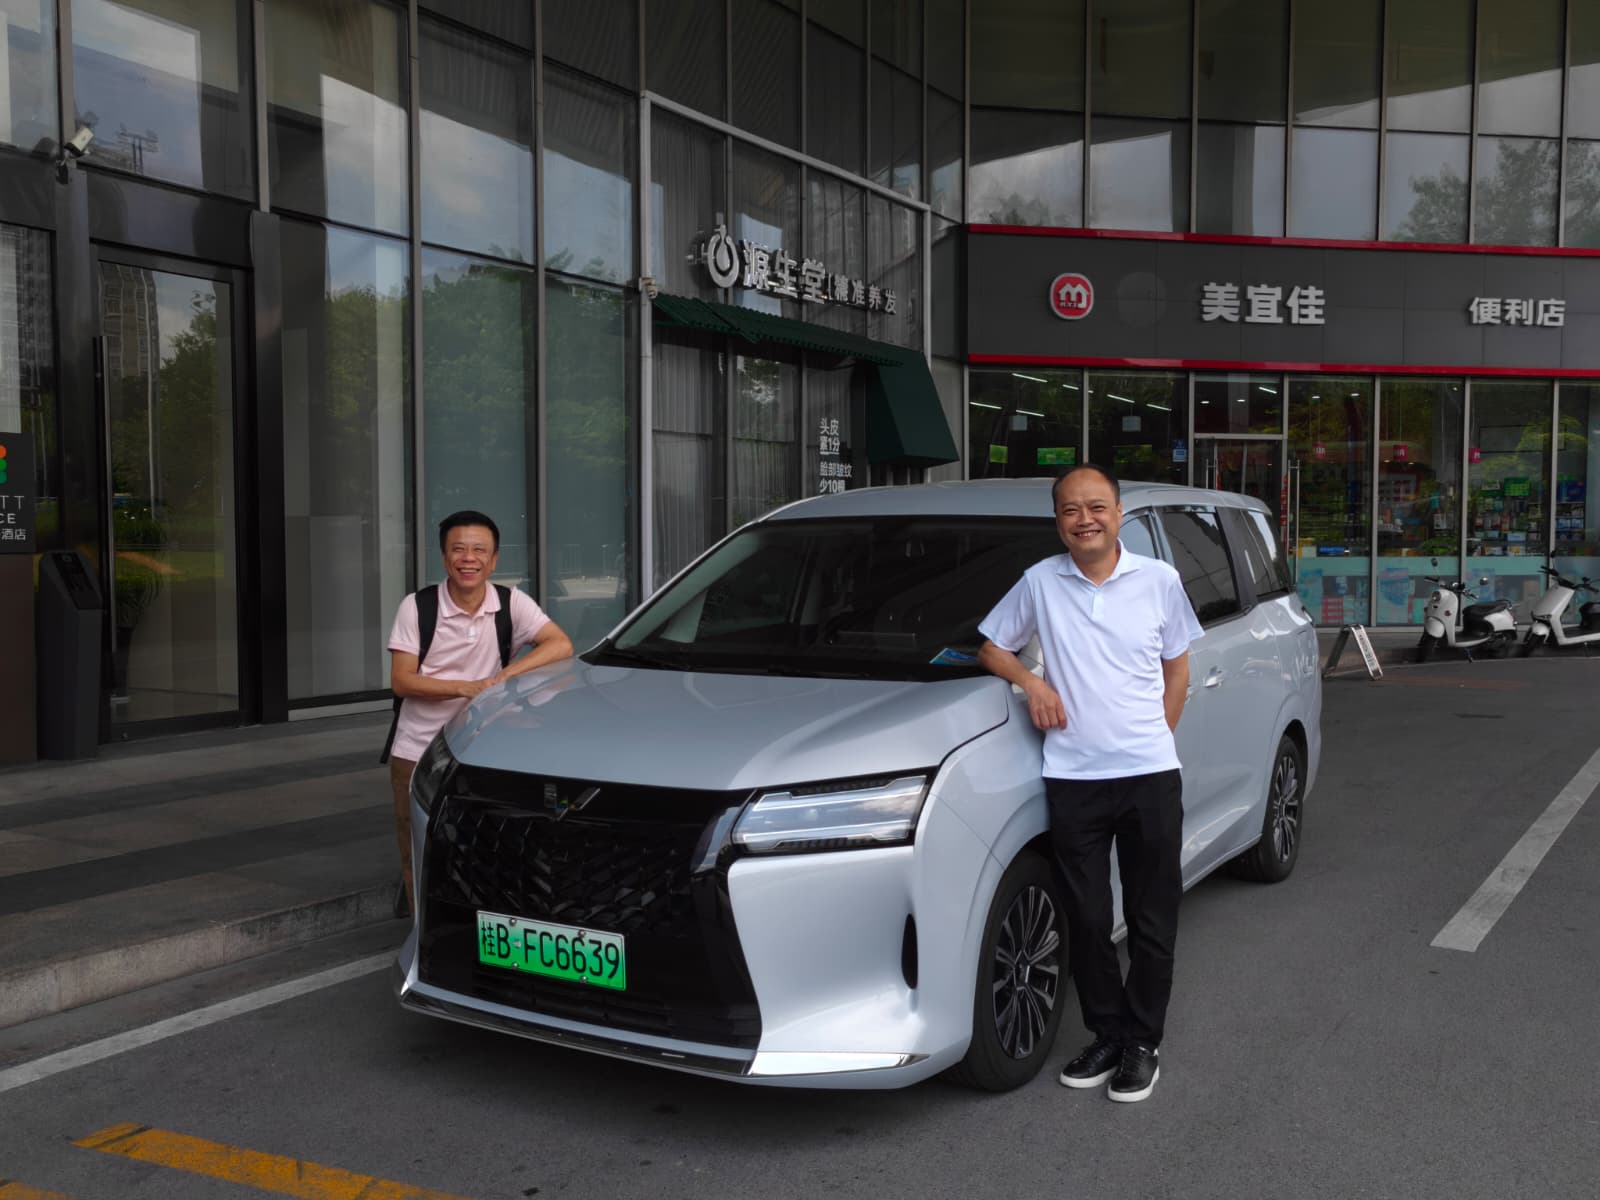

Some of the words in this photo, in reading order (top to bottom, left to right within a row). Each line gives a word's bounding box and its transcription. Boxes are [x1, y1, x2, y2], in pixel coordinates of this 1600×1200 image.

[1201, 282, 1326, 324] 美宜佳
[1469, 297, 1566, 327] 便利店
